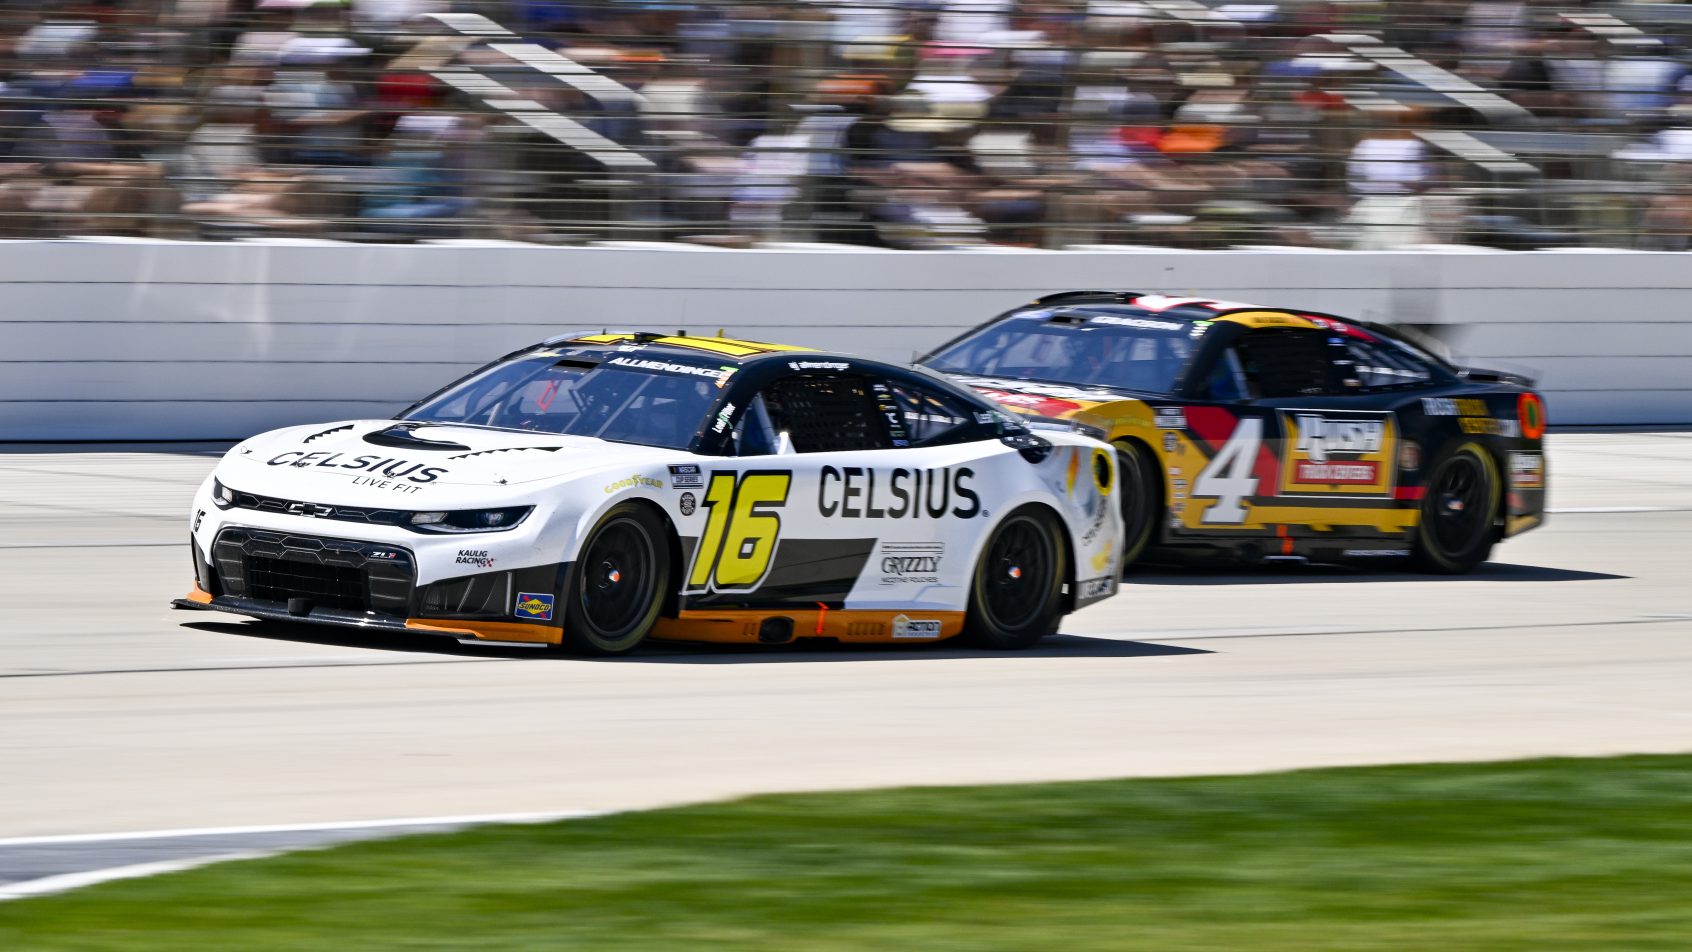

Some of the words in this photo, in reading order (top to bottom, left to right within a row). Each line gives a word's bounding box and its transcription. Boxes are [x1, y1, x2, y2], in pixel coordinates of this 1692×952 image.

[267, 452, 449, 483] CELSIUS
[1191, 417, 1263, 525] 4
[352, 476, 392, 489] LIVE
[392, 483, 423, 494] FIT
[604, 474, 664, 494] GOODYEAR
[818, 464, 983, 519] CELSIUS
[682, 470, 792, 595] 16
[455, 557, 486, 565] RACING
[458, 549, 488, 558] KAULIG
[881, 556, 943, 576] GRIZZLY
[517, 602, 552, 613] SUNOCO
